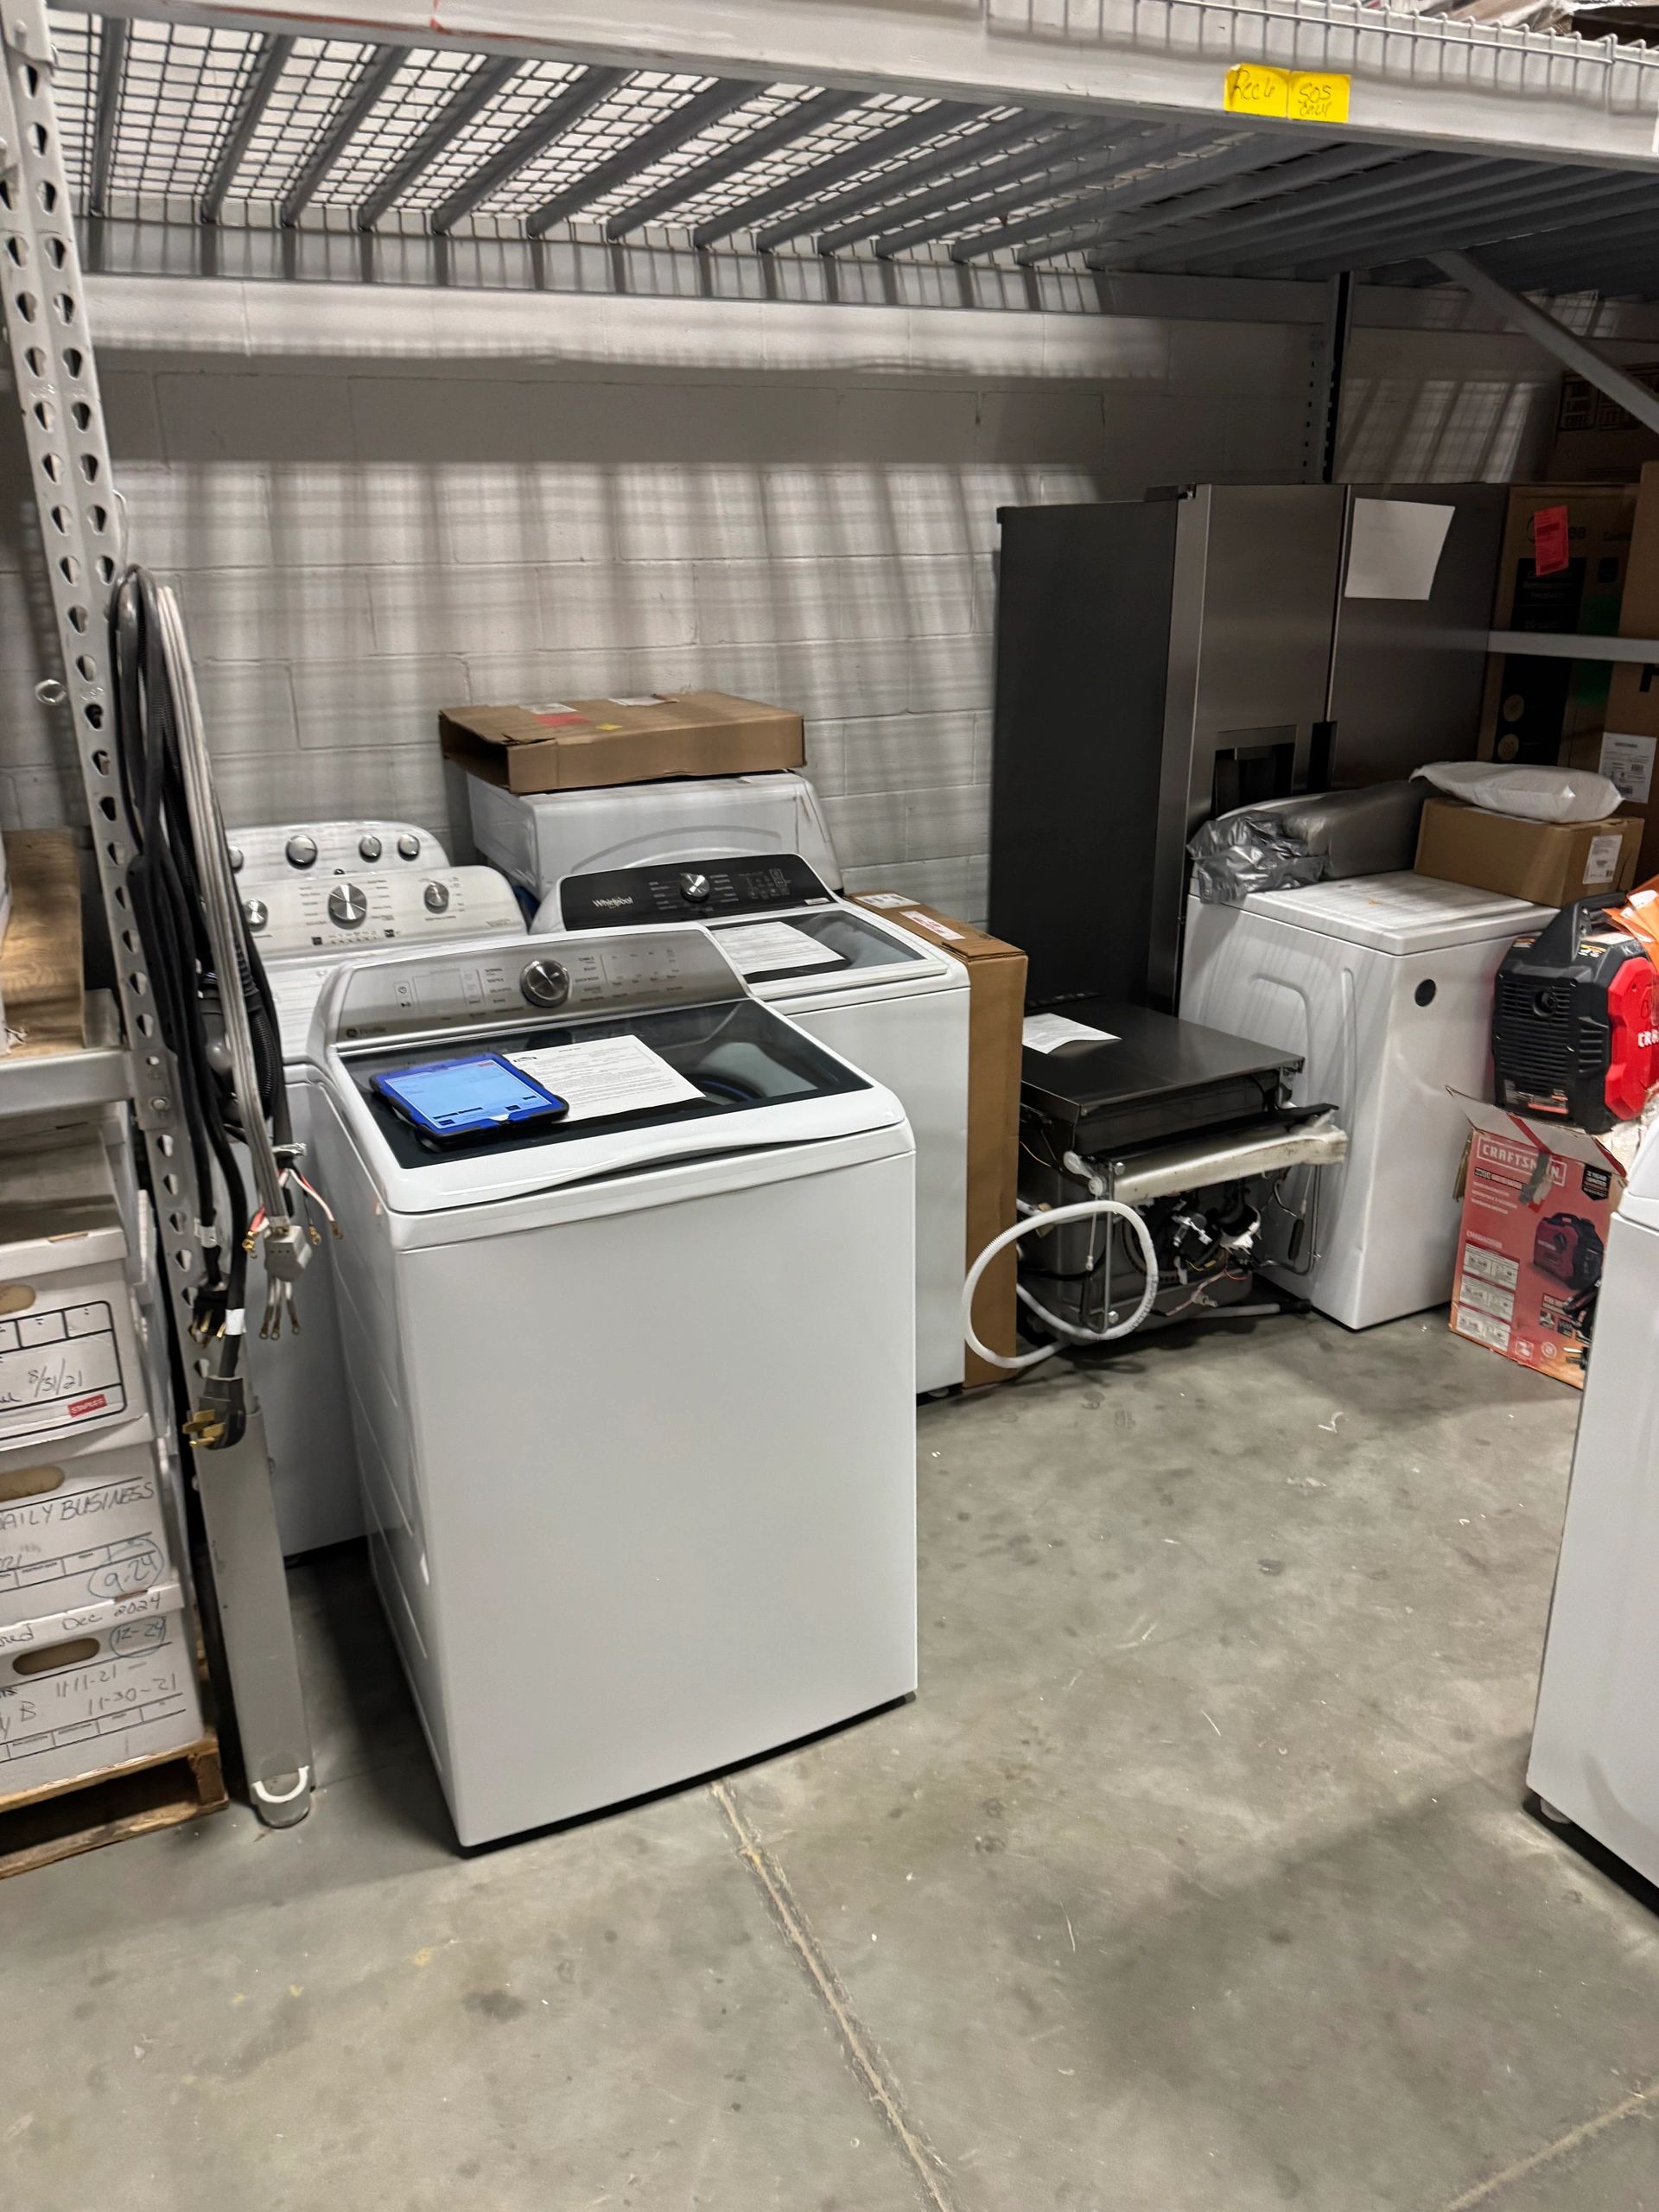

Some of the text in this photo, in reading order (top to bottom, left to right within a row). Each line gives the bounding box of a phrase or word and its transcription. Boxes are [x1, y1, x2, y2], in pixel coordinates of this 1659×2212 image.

[1300, 82, 1332, 104] SOS
[592, 896, 633, 909] Whirlpool
[60, 1482, 155, 1521] BUSINESS
[114, 1591, 161, 1618] 2024
